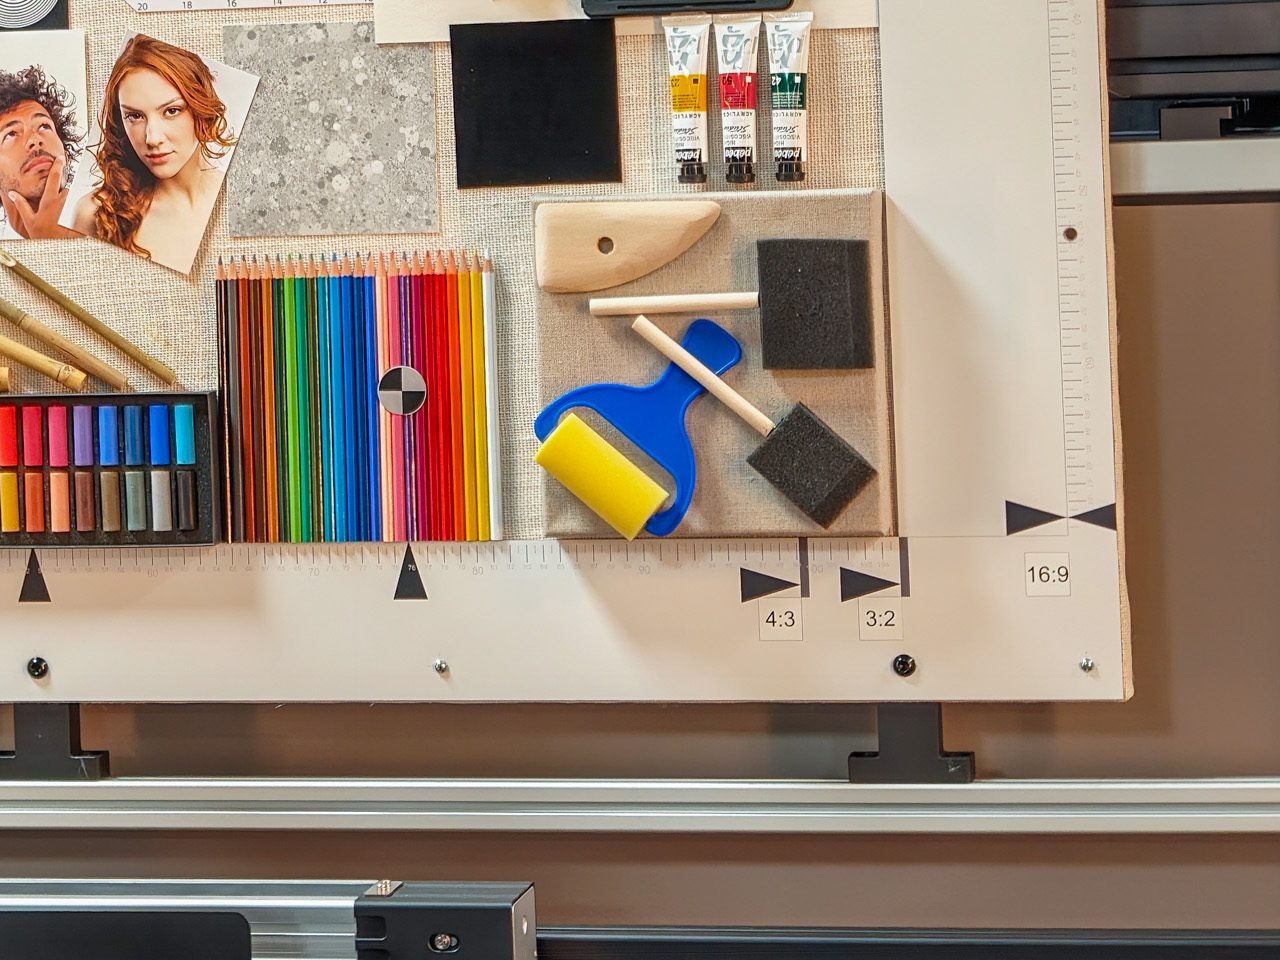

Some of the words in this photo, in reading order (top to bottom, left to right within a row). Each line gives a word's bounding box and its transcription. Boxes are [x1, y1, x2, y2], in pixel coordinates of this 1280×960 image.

[138, 2, 148, 10] 20
[227, 0, 237, 7] 16
[771, 76, 781, 85] 42
[1027, 566, 1070, 584] 16:9
[765, 610, 796, 628] 4:3
[866, 610, 896, 628] 3:2
